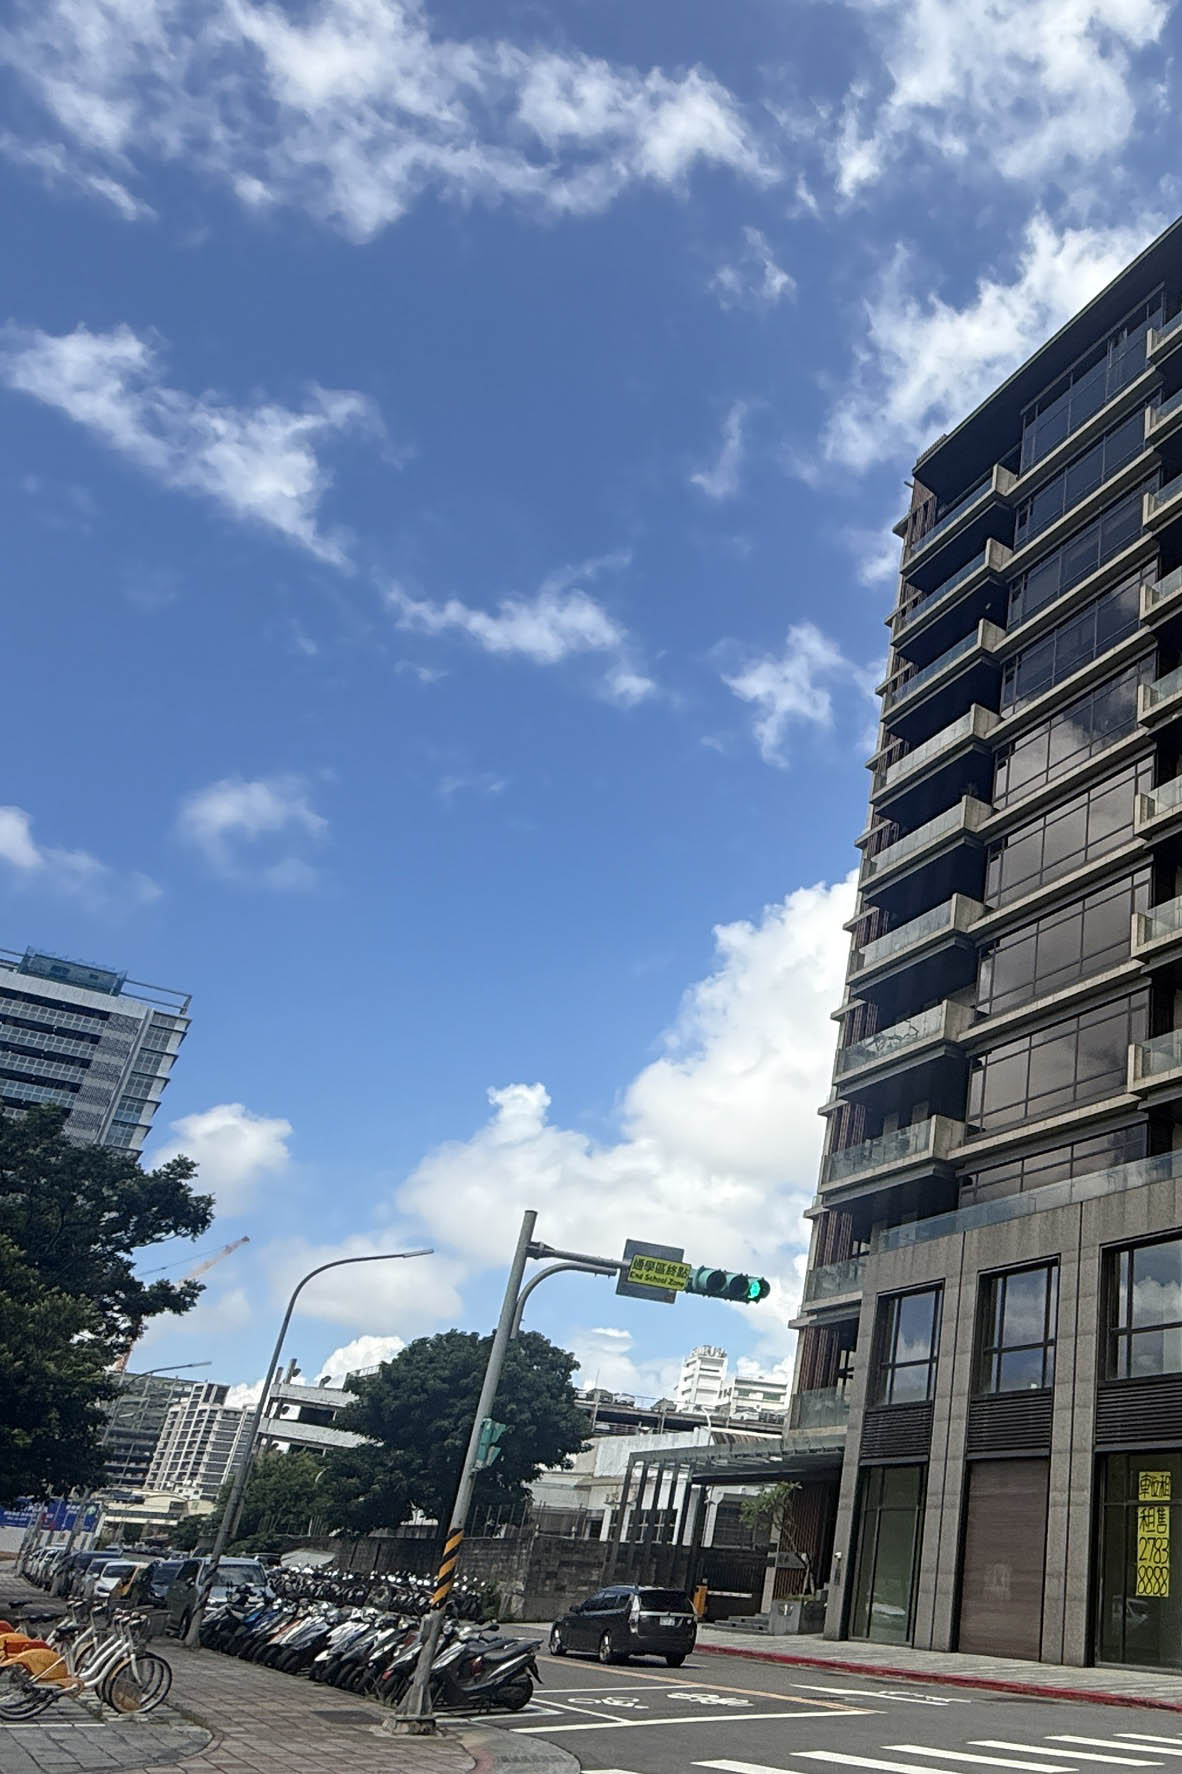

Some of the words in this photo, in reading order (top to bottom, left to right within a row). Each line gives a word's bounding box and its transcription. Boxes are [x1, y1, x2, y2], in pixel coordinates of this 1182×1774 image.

[630, 1271, 644, 1280] End
[645, 1273, 667, 1284] School
[667, 1279, 685, 1288] Zone
[1138, 1507, 1167, 1534] 租售
[1138, 1537, 1169, 1565] 2783
[1138, 1565, 1169, 1596] 8888
